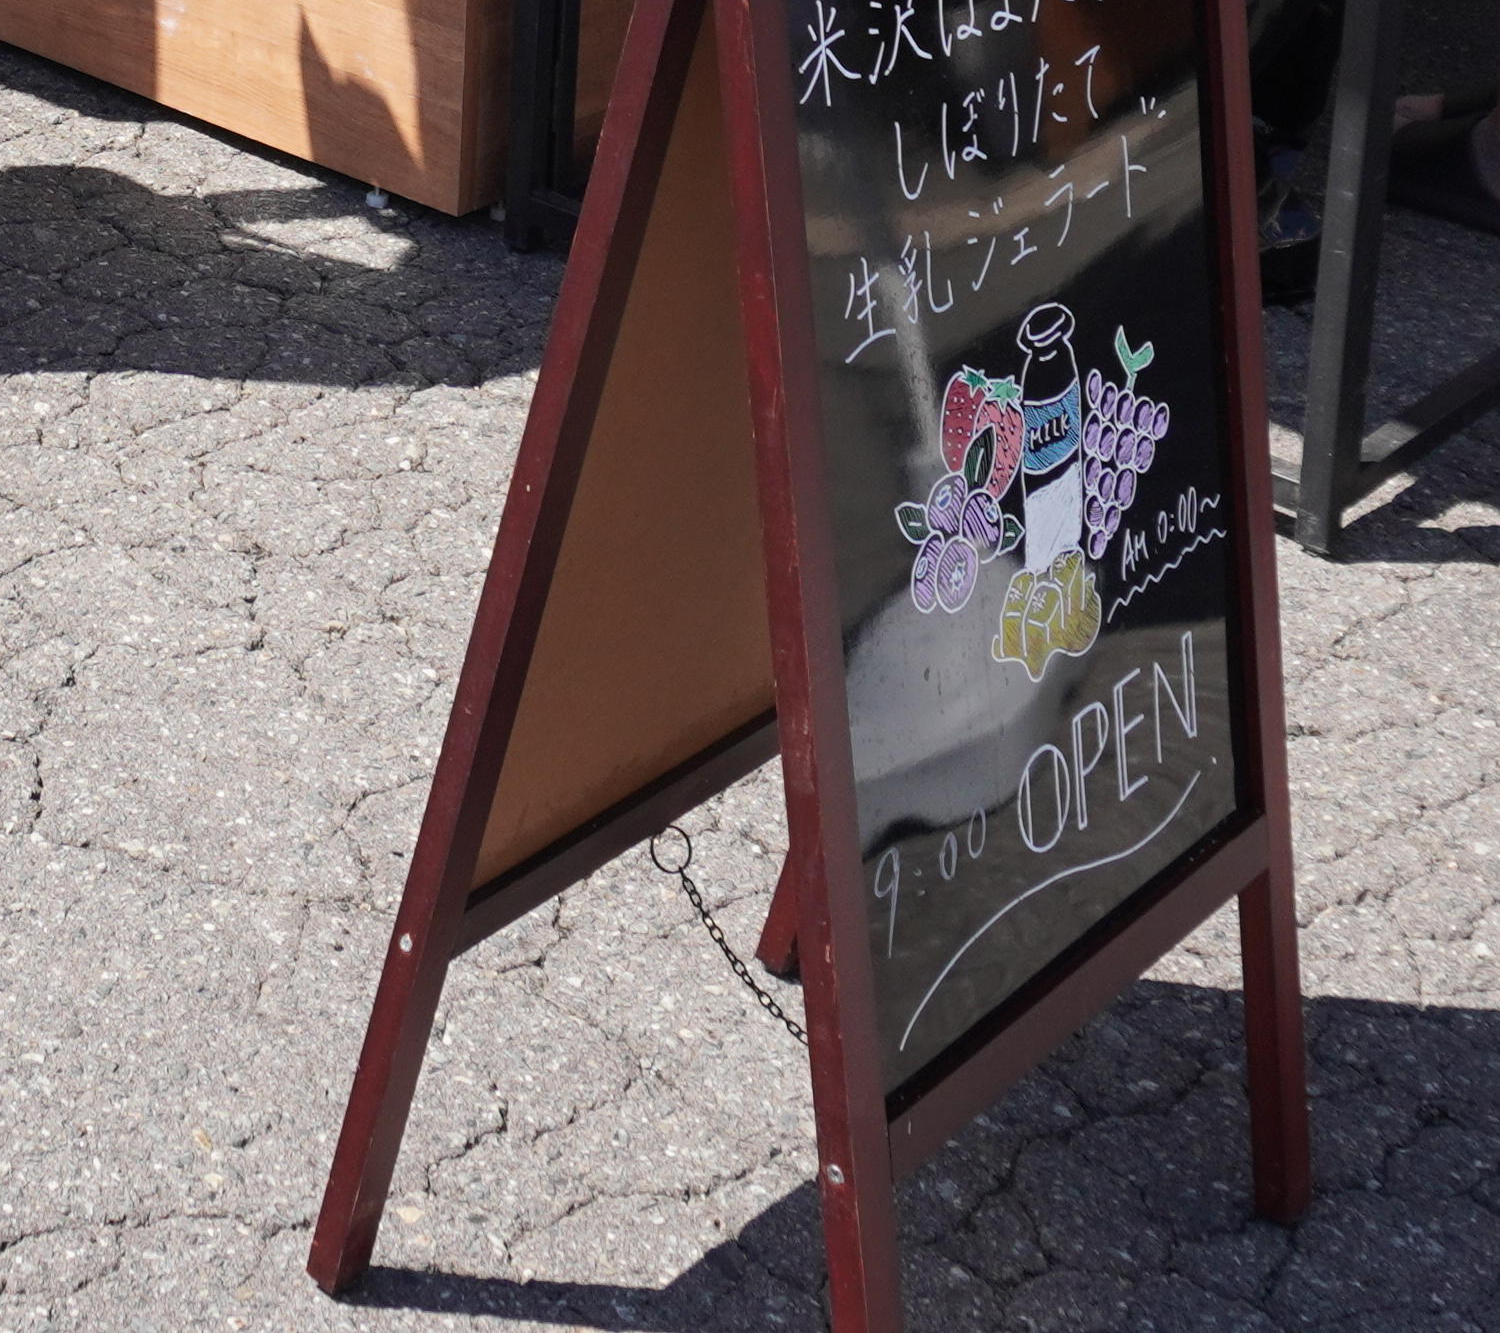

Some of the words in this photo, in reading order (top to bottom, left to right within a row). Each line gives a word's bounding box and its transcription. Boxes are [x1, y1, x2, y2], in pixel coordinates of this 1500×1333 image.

[894, 44, 1101, 201] しぼりたて
[844, 96, 1168, 364] 生乳ジェラート
[1029, 414, 1070, 451] MILK
[1017, 631, 1198, 855] OPEN
